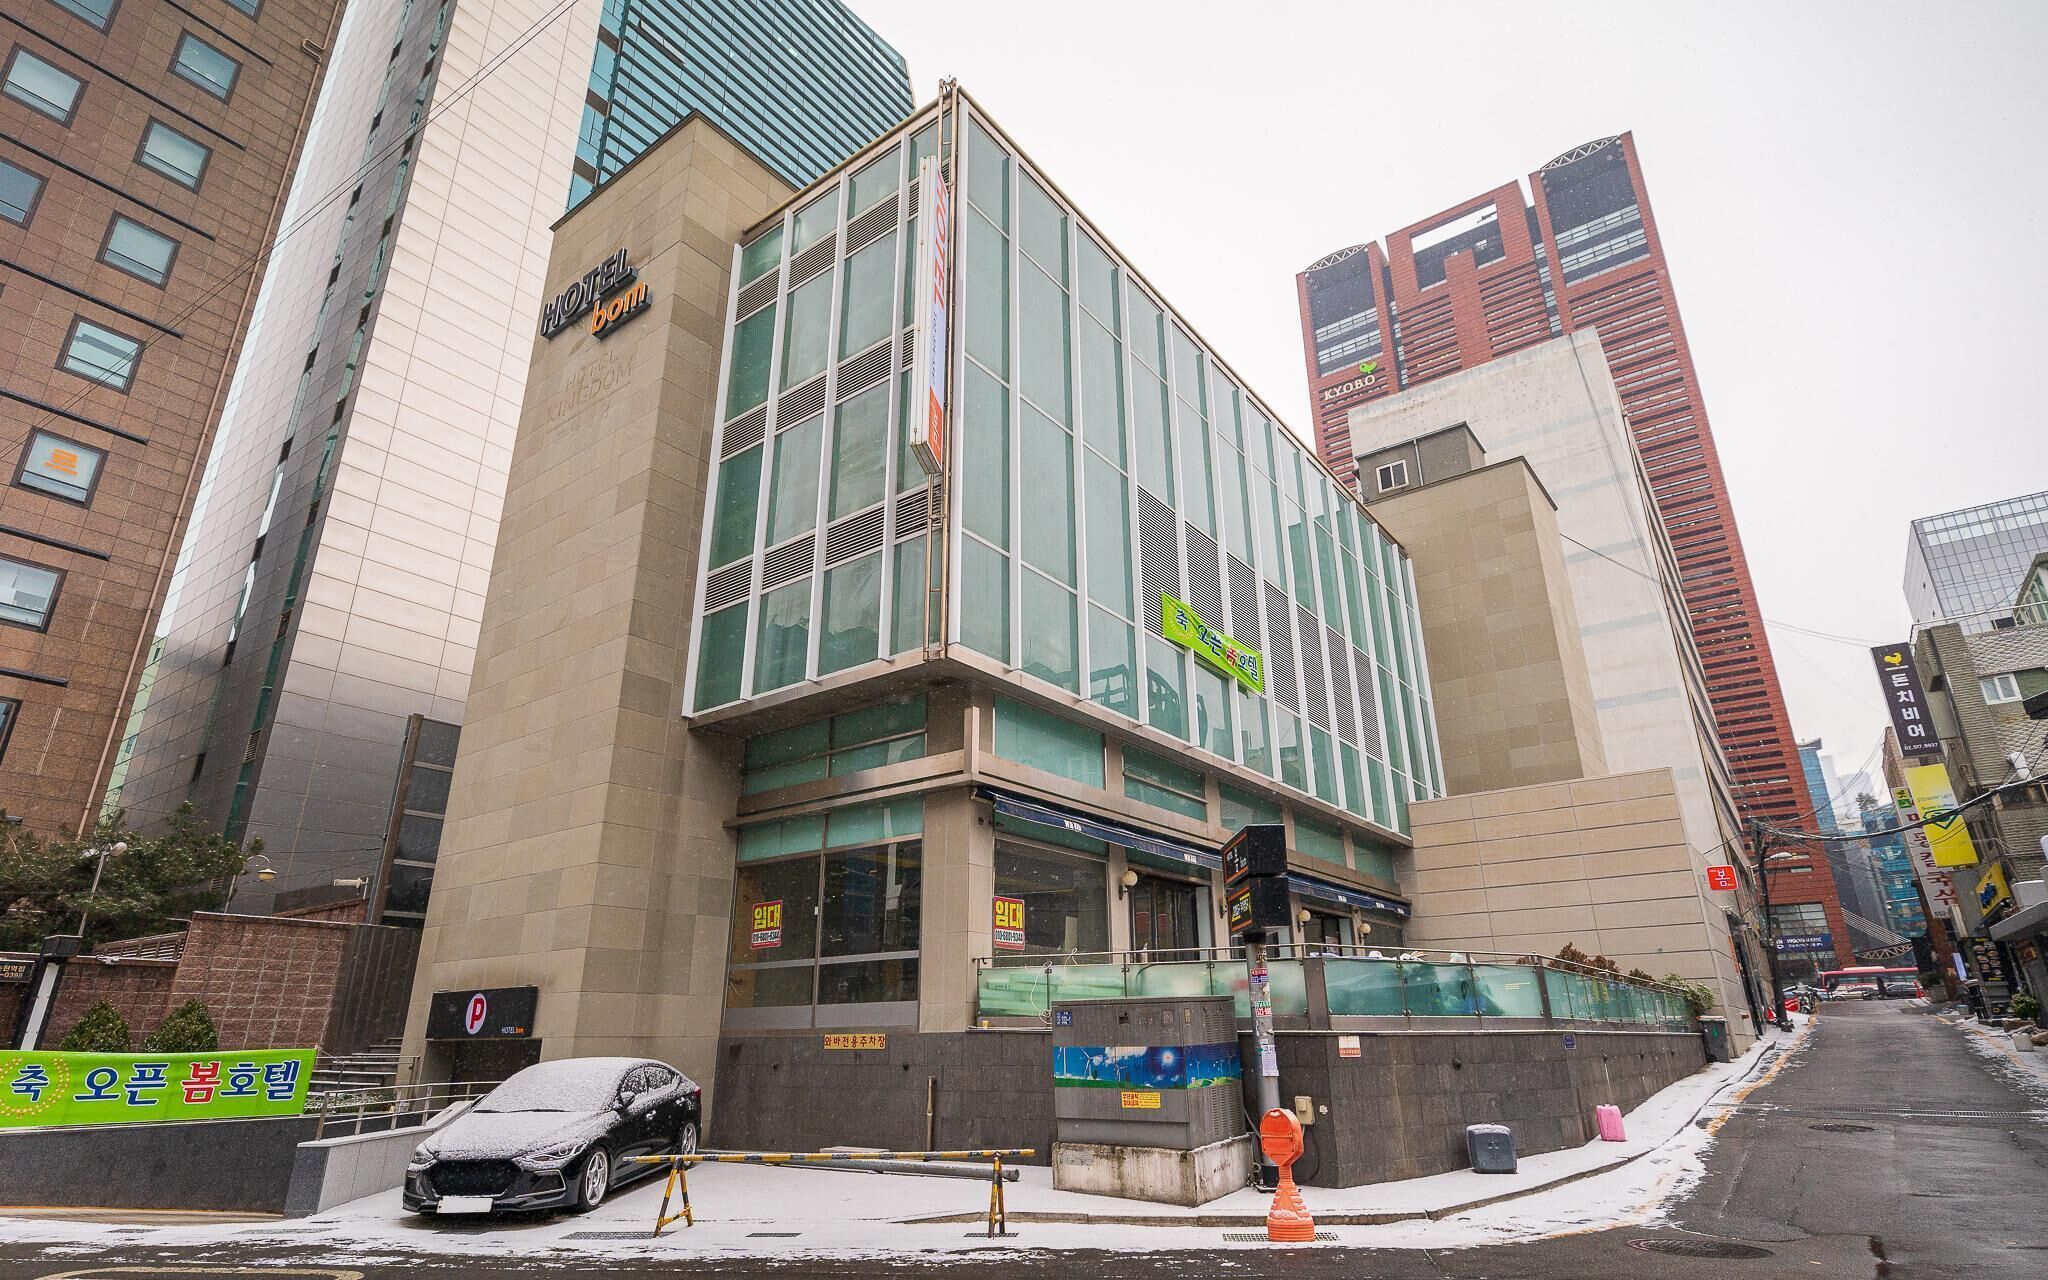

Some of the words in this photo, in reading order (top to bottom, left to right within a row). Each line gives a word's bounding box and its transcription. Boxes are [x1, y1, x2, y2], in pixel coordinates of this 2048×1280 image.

[934, 169, 947, 309] HOTEL
[540, 247, 633, 336] HOTEL
[591, 281, 650, 335] bom
[1324, 374, 1376, 401] KYOBO
[1197, 624, 1223, 657] 오픈
[1714, 869, 1731, 887] 봄
[754, 904, 780, 930] 임대
[995, 900, 1023, 928] 임대
[469, 998, 485, 1030] P
[824, 1035, 886, 1048] 와바전용주차장
[11, 1064, 49, 1102] 축
[74, 1062, 170, 1106] 오픈
